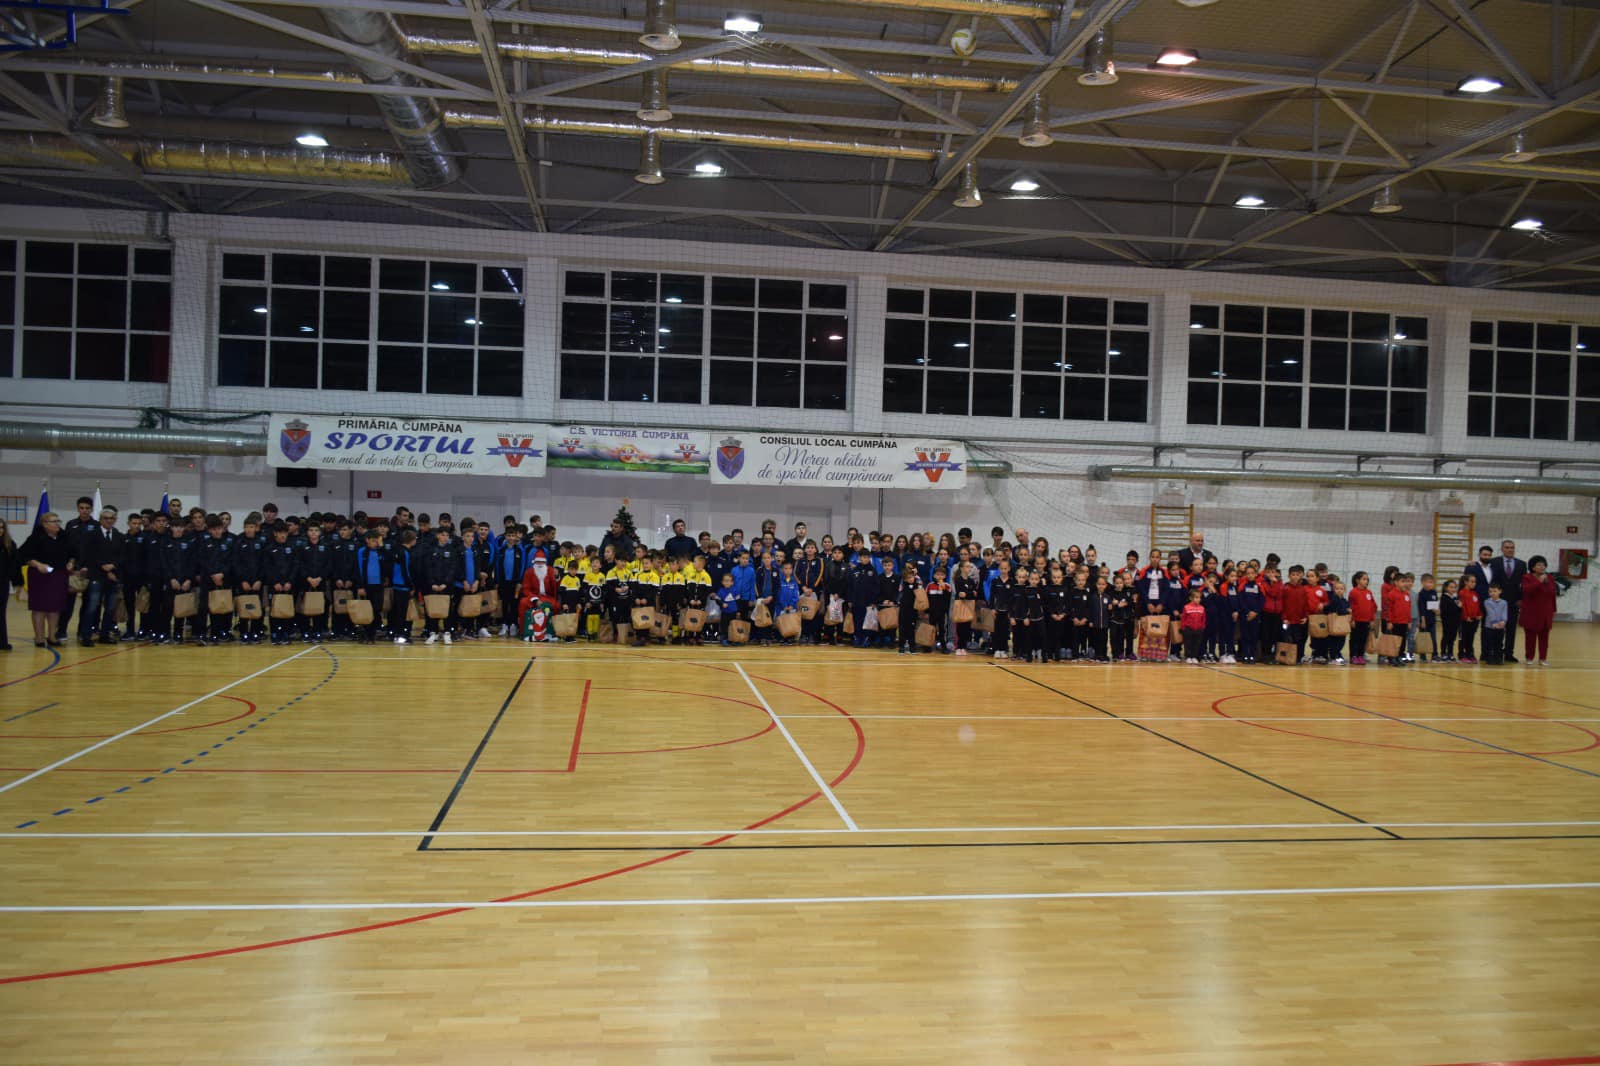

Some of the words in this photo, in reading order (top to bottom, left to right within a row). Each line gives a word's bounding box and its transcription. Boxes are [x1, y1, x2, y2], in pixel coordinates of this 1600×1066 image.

[591, 428, 638, 438] VICTORIA
[324, 432, 475, 455] SPORTUL
[759, 436, 812, 446] CONSILIUL
[814, 438, 847, 448] LOCAL
[338, 453, 364, 465] mod
[774, 446, 830, 468] Mereu
[757, 463, 773, 479] de
[776, 466, 822, 485] sportul
